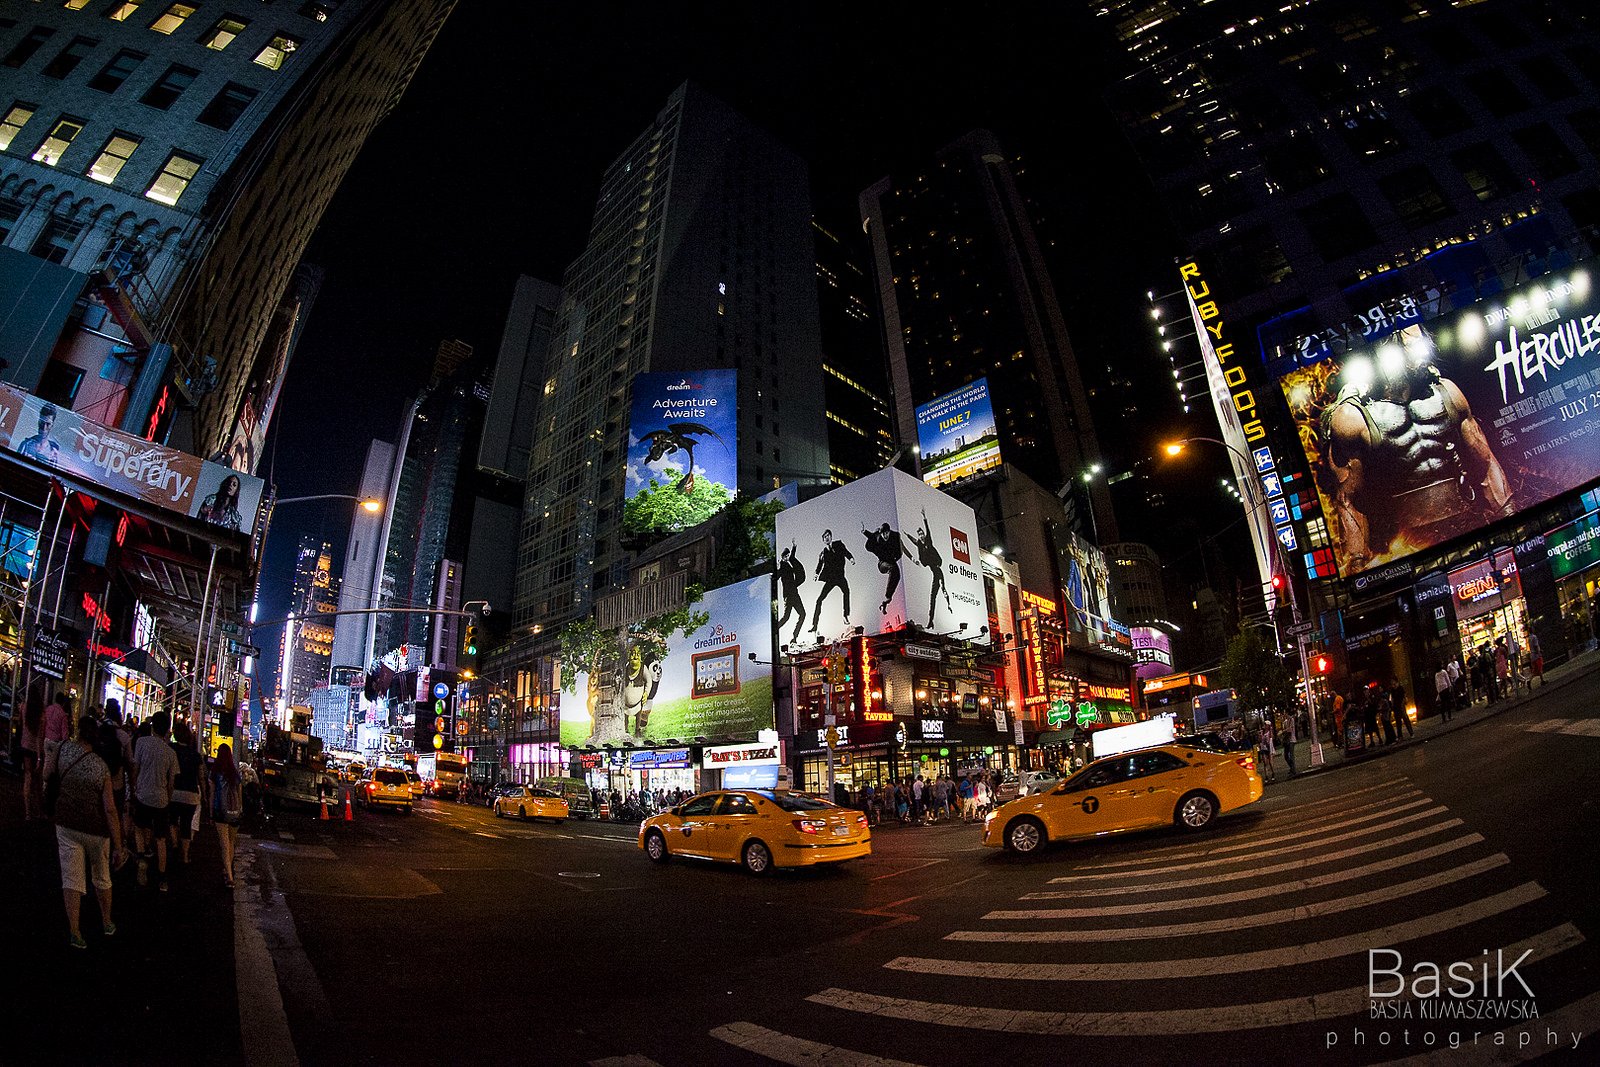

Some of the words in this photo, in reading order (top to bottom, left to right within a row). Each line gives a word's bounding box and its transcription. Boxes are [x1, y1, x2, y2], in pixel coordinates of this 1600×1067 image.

[653, 398, 717, 408] Adventure
[919, 401, 950, 418] CHANGING
[950, 396, 962, 405] THE
[962, 385, 986, 399] WORLD
[931, 408, 949, 419] WALK
[957, 400, 969, 408] THE
[969, 392, 987, 403] PARK
[1560, 397, 1588, 422] JULY
[663, 408, 705, 418] Awaits
[939, 413, 963, 432] JUNE
[964, 410, 971, 419] 7
[1501, 436, 1517, 448] MGM
[1565, 543, 1592, 560] COFFEE
[949, 564, 958, 574] go
[960, 565, 978, 580] there
[694, 632, 737, 649] dreamtab
[1030, 617, 1045, 693] PLAYWRIGHT
[1025, 695, 1047, 705] TAVERN
[864, 712, 893, 721] TAVERN
[921, 720, 944, 733] ROAST
[711, 751, 740, 762] RAY'S
[742, 748, 777, 761] PIZZA
